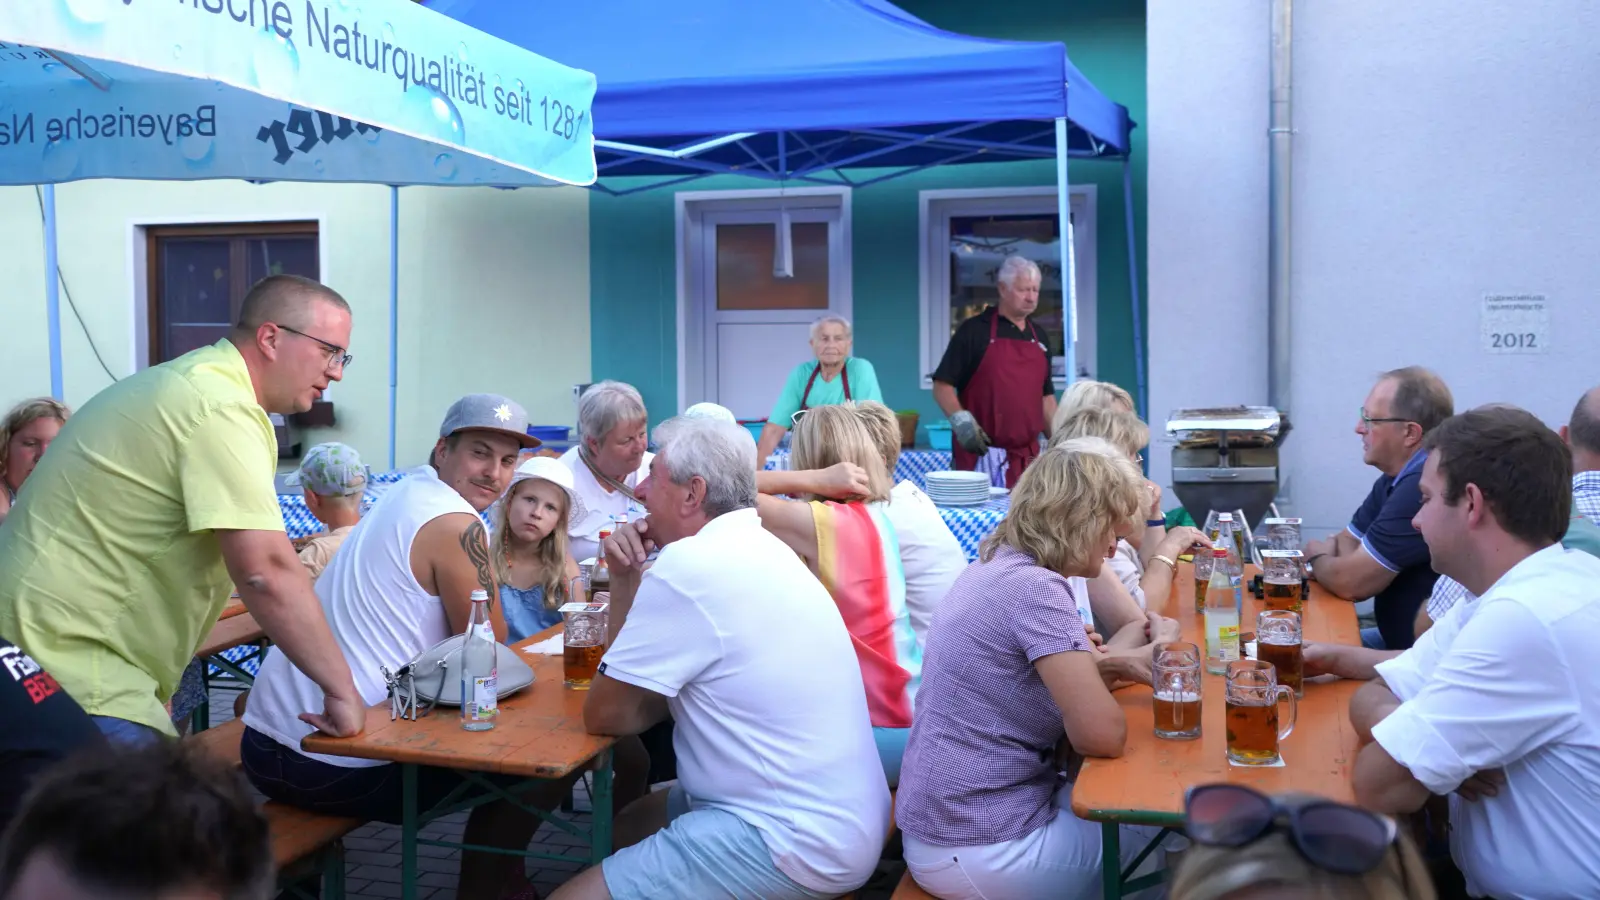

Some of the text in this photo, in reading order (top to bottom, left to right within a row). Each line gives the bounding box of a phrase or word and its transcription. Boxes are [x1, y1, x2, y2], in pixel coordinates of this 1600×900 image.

[306, 0, 487, 109] Naturqualität
[494, 86, 532, 126] seit
[1491, 333, 1537, 348] 2012
